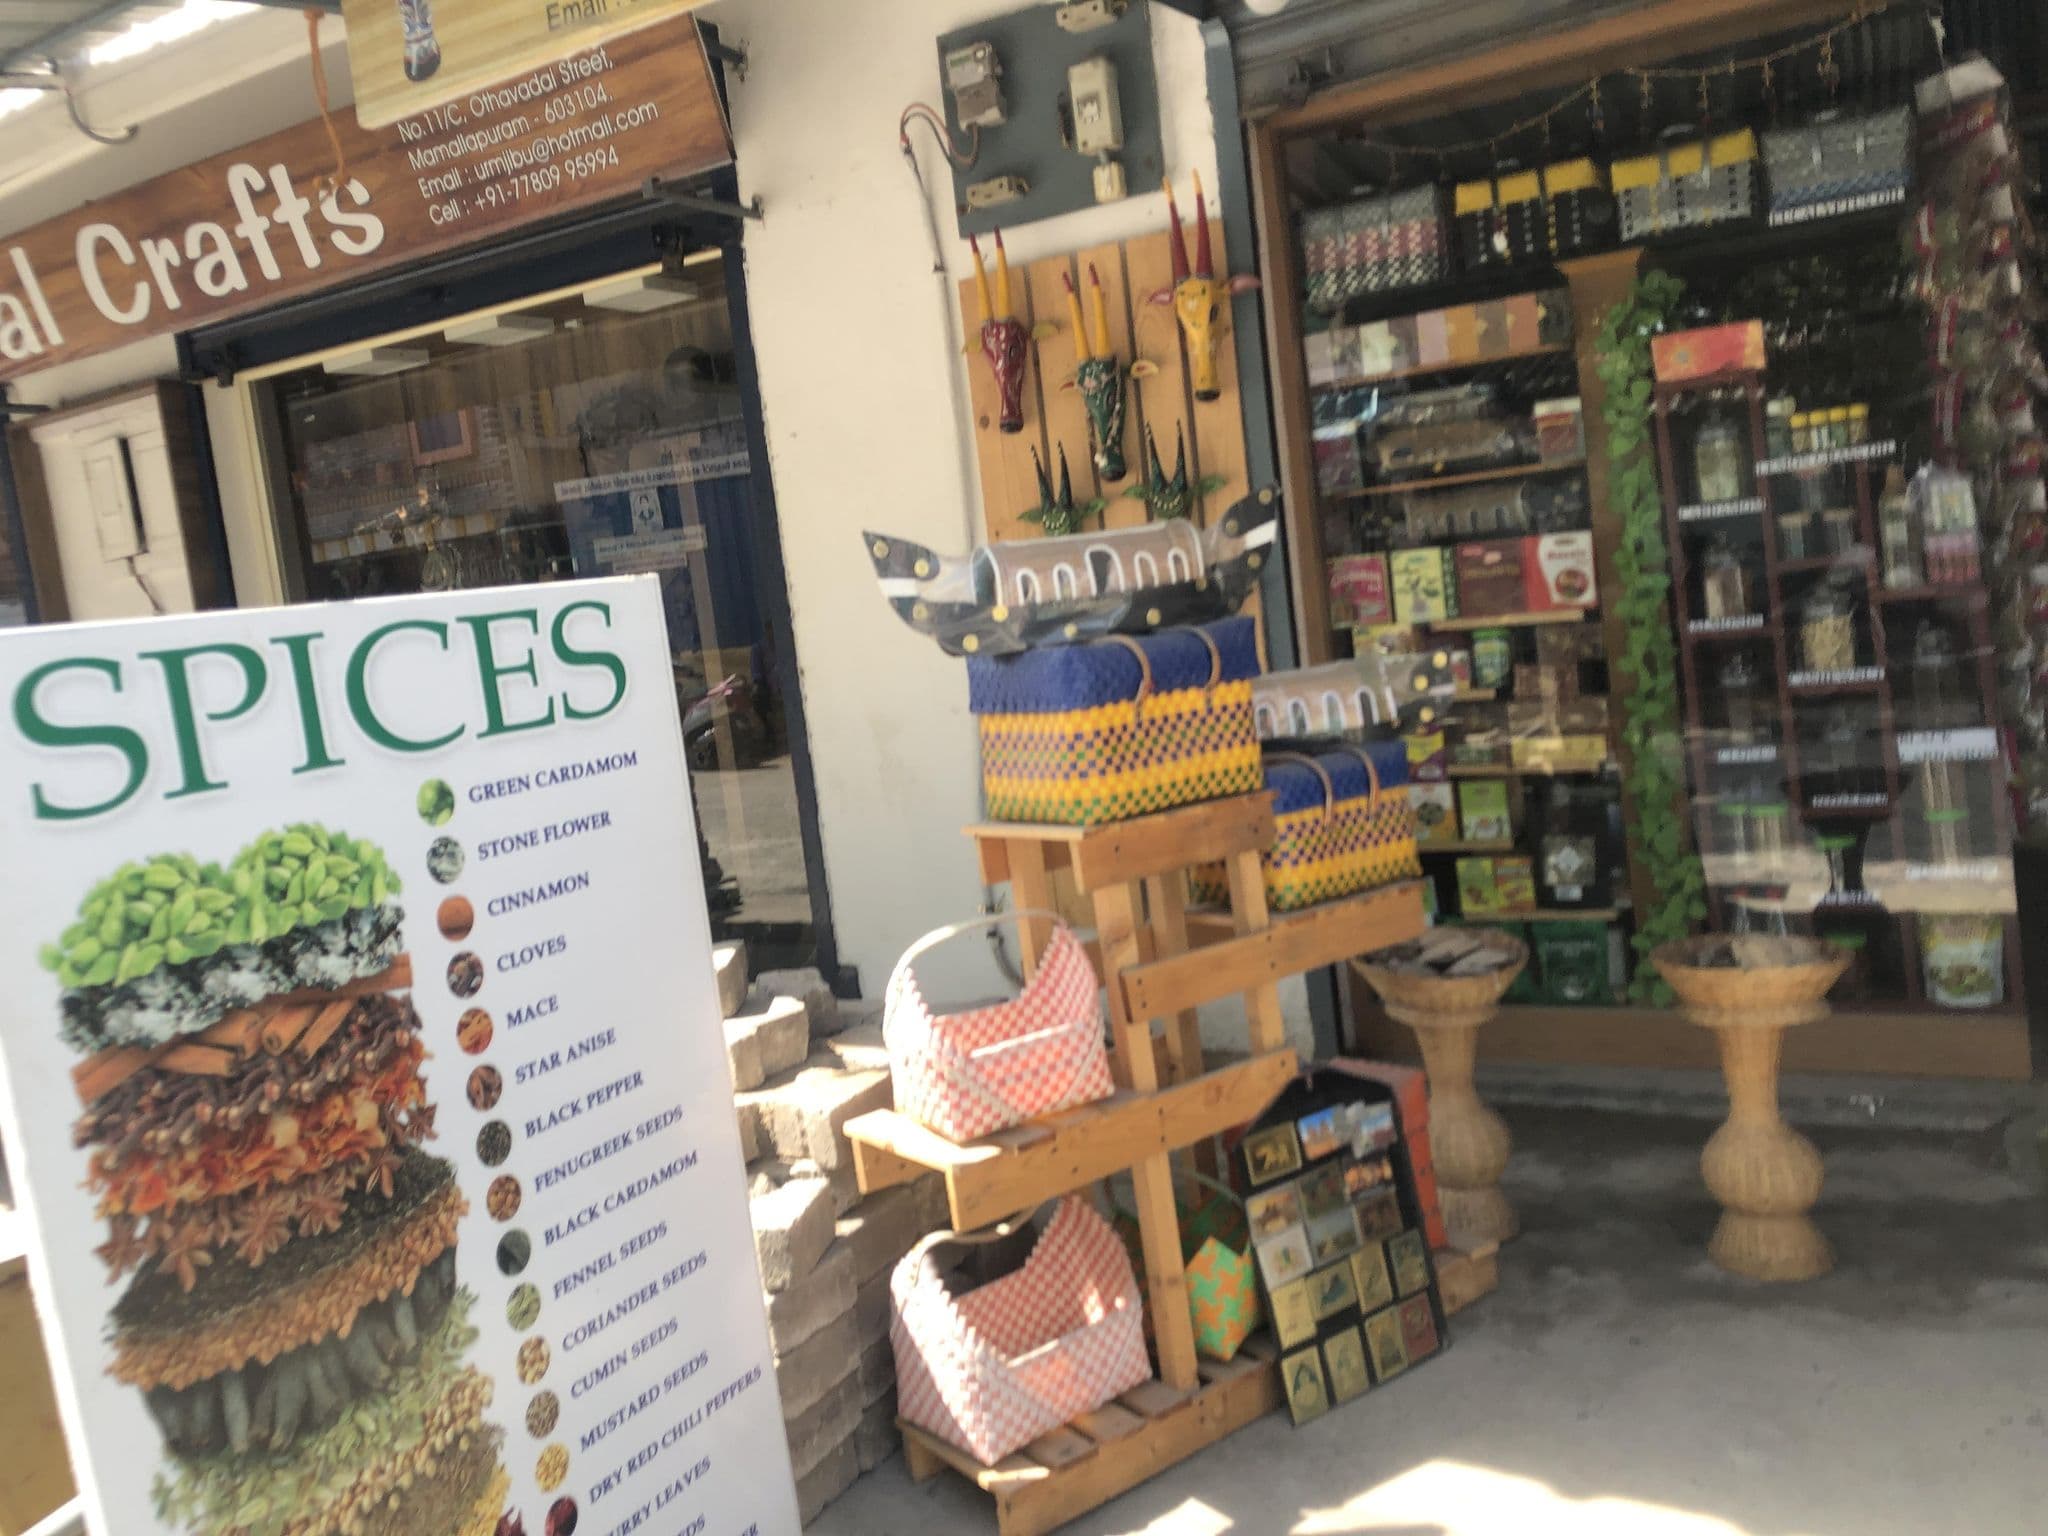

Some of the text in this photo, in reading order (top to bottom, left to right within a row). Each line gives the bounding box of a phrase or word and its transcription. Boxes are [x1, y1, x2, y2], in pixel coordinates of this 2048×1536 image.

[558, 47, 613, 85] Street,
[408, 114, 530, 170] Mamallapuram
[417, 169, 462, 199] Email
[429, 199, 461, 225] Cell
[475, 165, 560, 211] +91-77809
[565, 144, 619, 181] 95994
[76, 163, 384, 324] Crafts
[10, 599, 628, 820] SPICES
[468, 750, 638, 804] GREEN CARDAMOM
[477, 810, 612, 862] STONE FLOWER
[487, 870, 590, 917] CINNAMON
[496, 934, 567, 972] CLOVES
[506, 994, 559, 1029] MACE
[515, 1027, 617, 1085] STAR ANISE
[525, 1070, 643, 1139] BLACK PEPPER
[534, 1104, 683, 1194] FENUGREEK SEEDS
[544, 1149, 698, 1247] BLACK CARDAMOM
[553, 1220, 668, 1301] FENNEL SEEDS
[562, 1249, 707, 1352] CORIANDER SEEDS
[570, 1316, 678, 1399] CUMIN SEEDS
[579, 1350, 709, 1453] MUSTARD SEEDS
[589, 1364, 762, 1504] DRY RED CHILI PEPPERS
[654, 1455, 711, 1511] LEAVES
